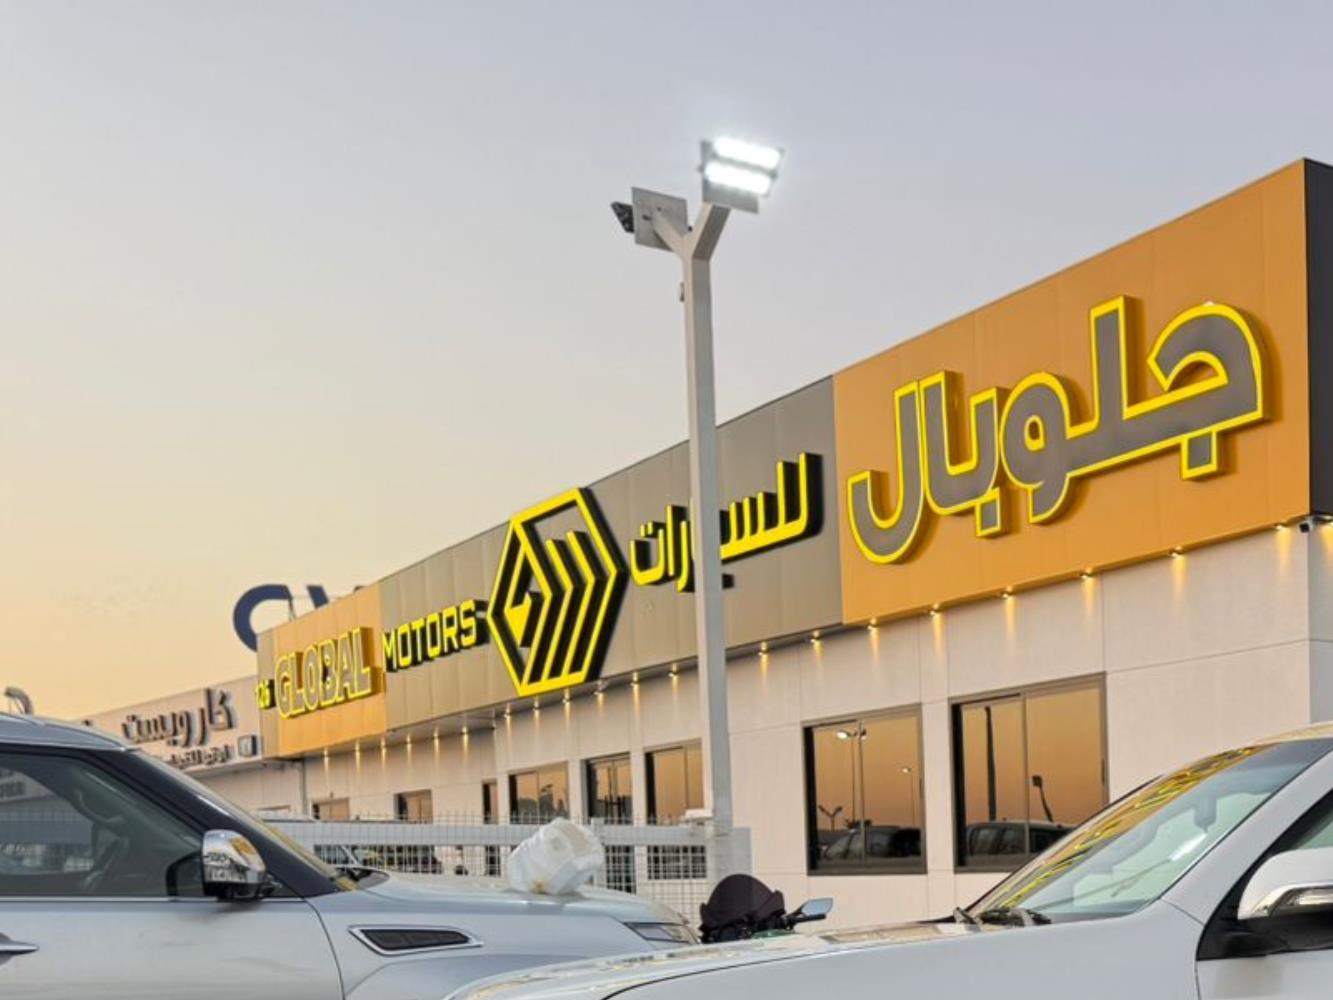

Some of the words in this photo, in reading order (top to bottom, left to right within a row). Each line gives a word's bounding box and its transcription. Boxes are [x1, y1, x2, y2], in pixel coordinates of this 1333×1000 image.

[847, 294, 1264, 565] جلوبال
[629, 452, 808, 594] للسرات
[273, 627, 373, 719] GLOBAL
[382, 599, 478, 671] MOTORS
